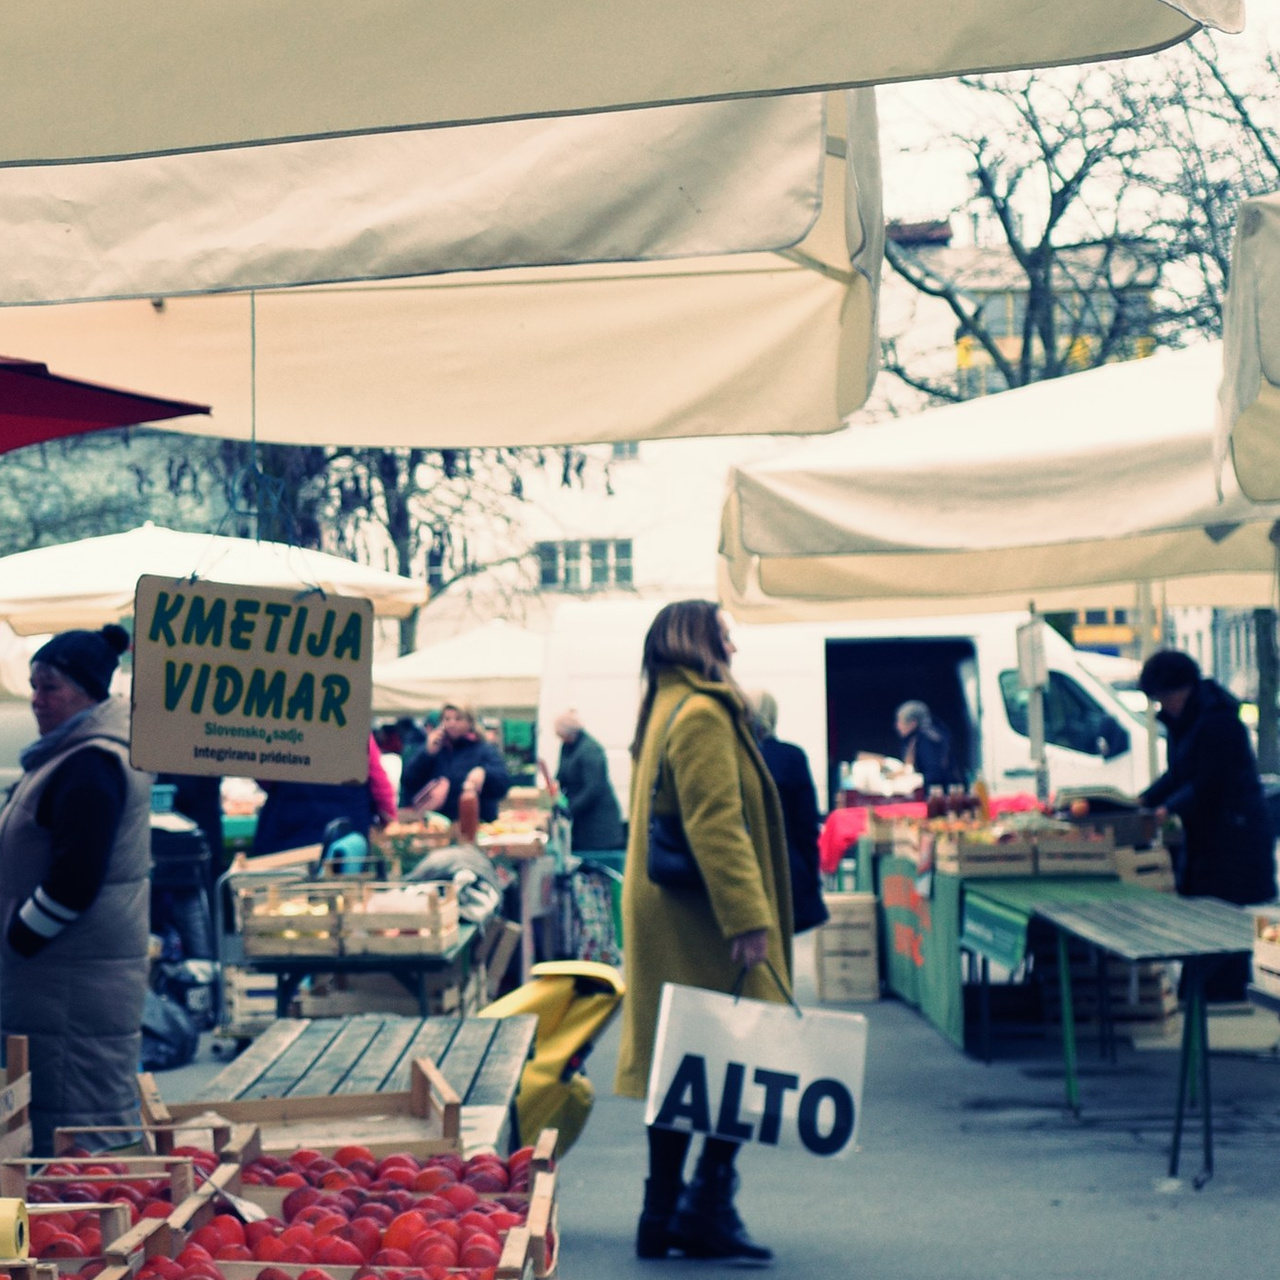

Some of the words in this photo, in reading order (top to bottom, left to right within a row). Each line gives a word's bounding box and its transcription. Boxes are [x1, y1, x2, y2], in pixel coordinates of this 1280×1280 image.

[149, 591, 362, 661] KMETIJA
[164, 660, 351, 727] VIDMAR
[652, 1053, 855, 1158] ALTO
